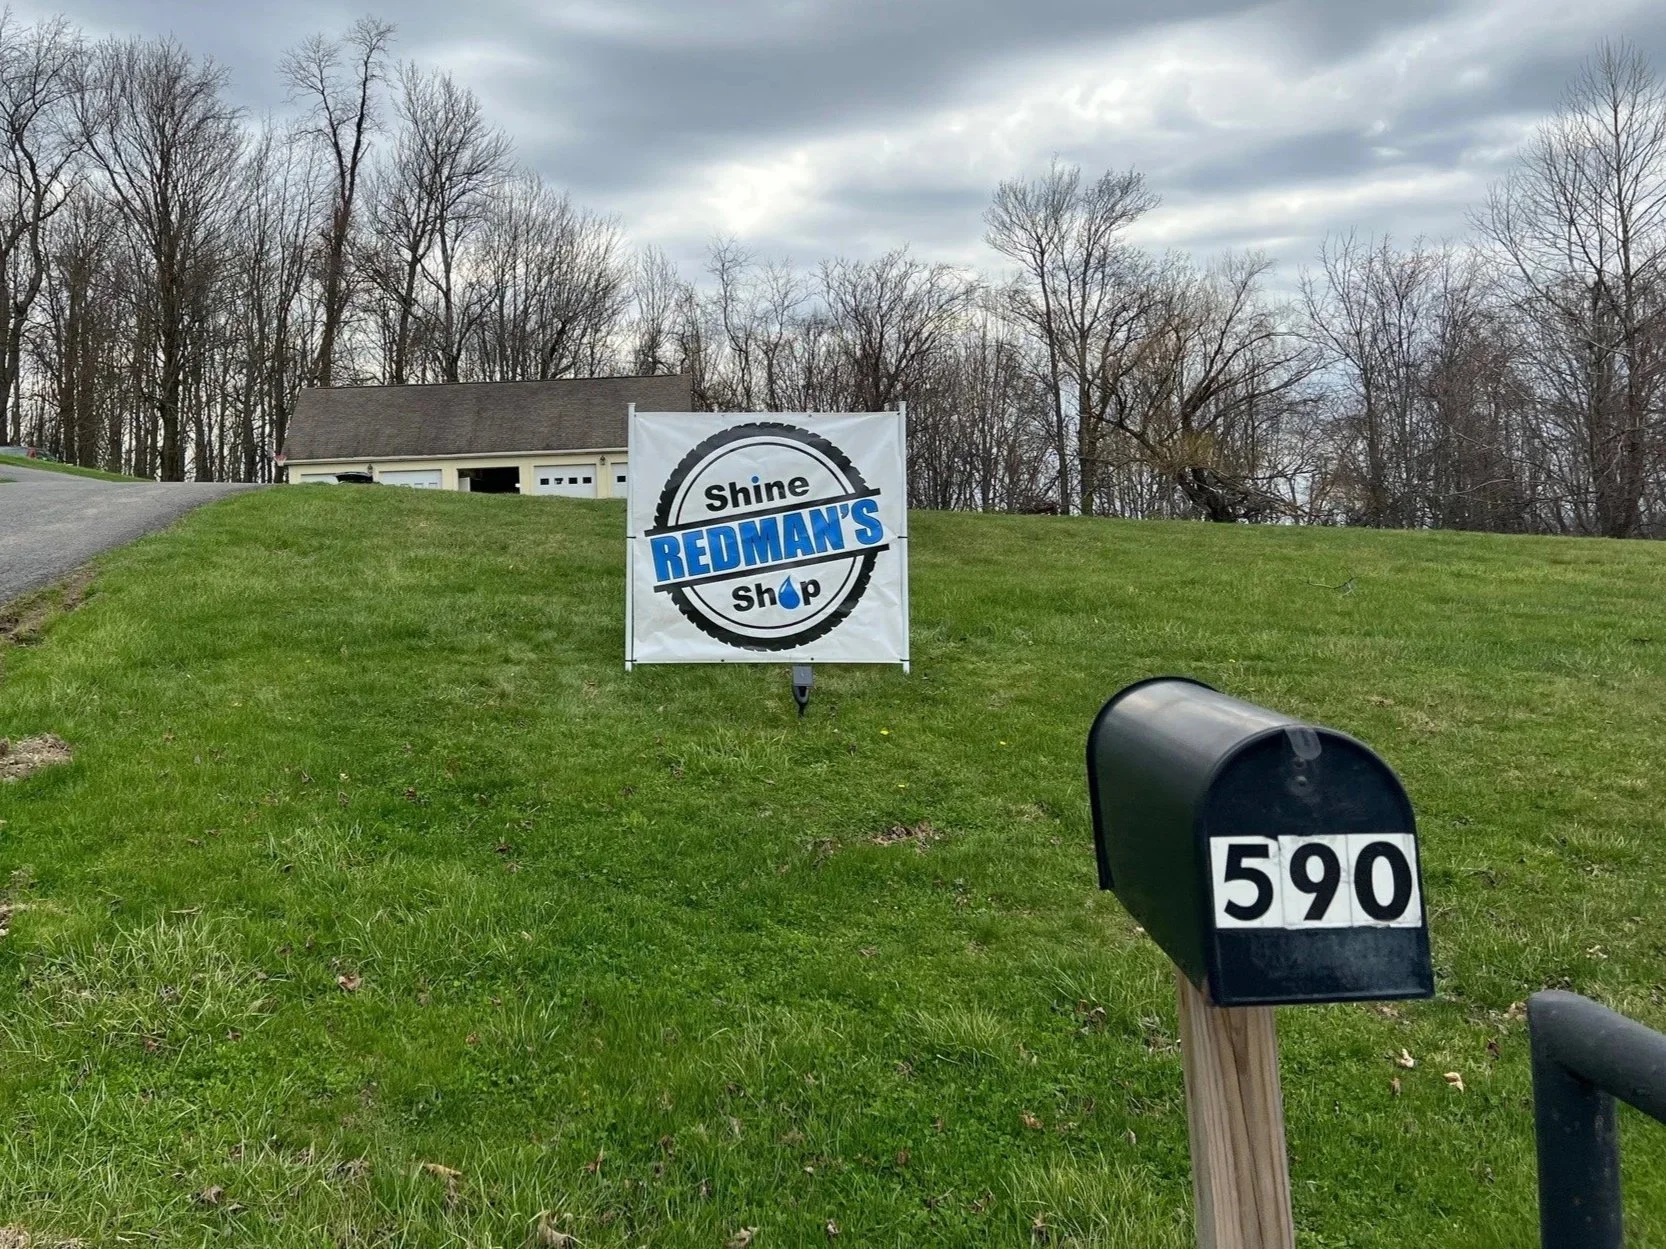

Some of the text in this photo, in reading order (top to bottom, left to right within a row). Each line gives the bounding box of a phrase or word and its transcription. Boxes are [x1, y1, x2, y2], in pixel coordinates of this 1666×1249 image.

[705, 476, 810, 512] Shine
[651, 499, 884, 582] REDMAN'S
[731, 576, 821, 612] Shop
[1225, 841, 1412, 921] 590
